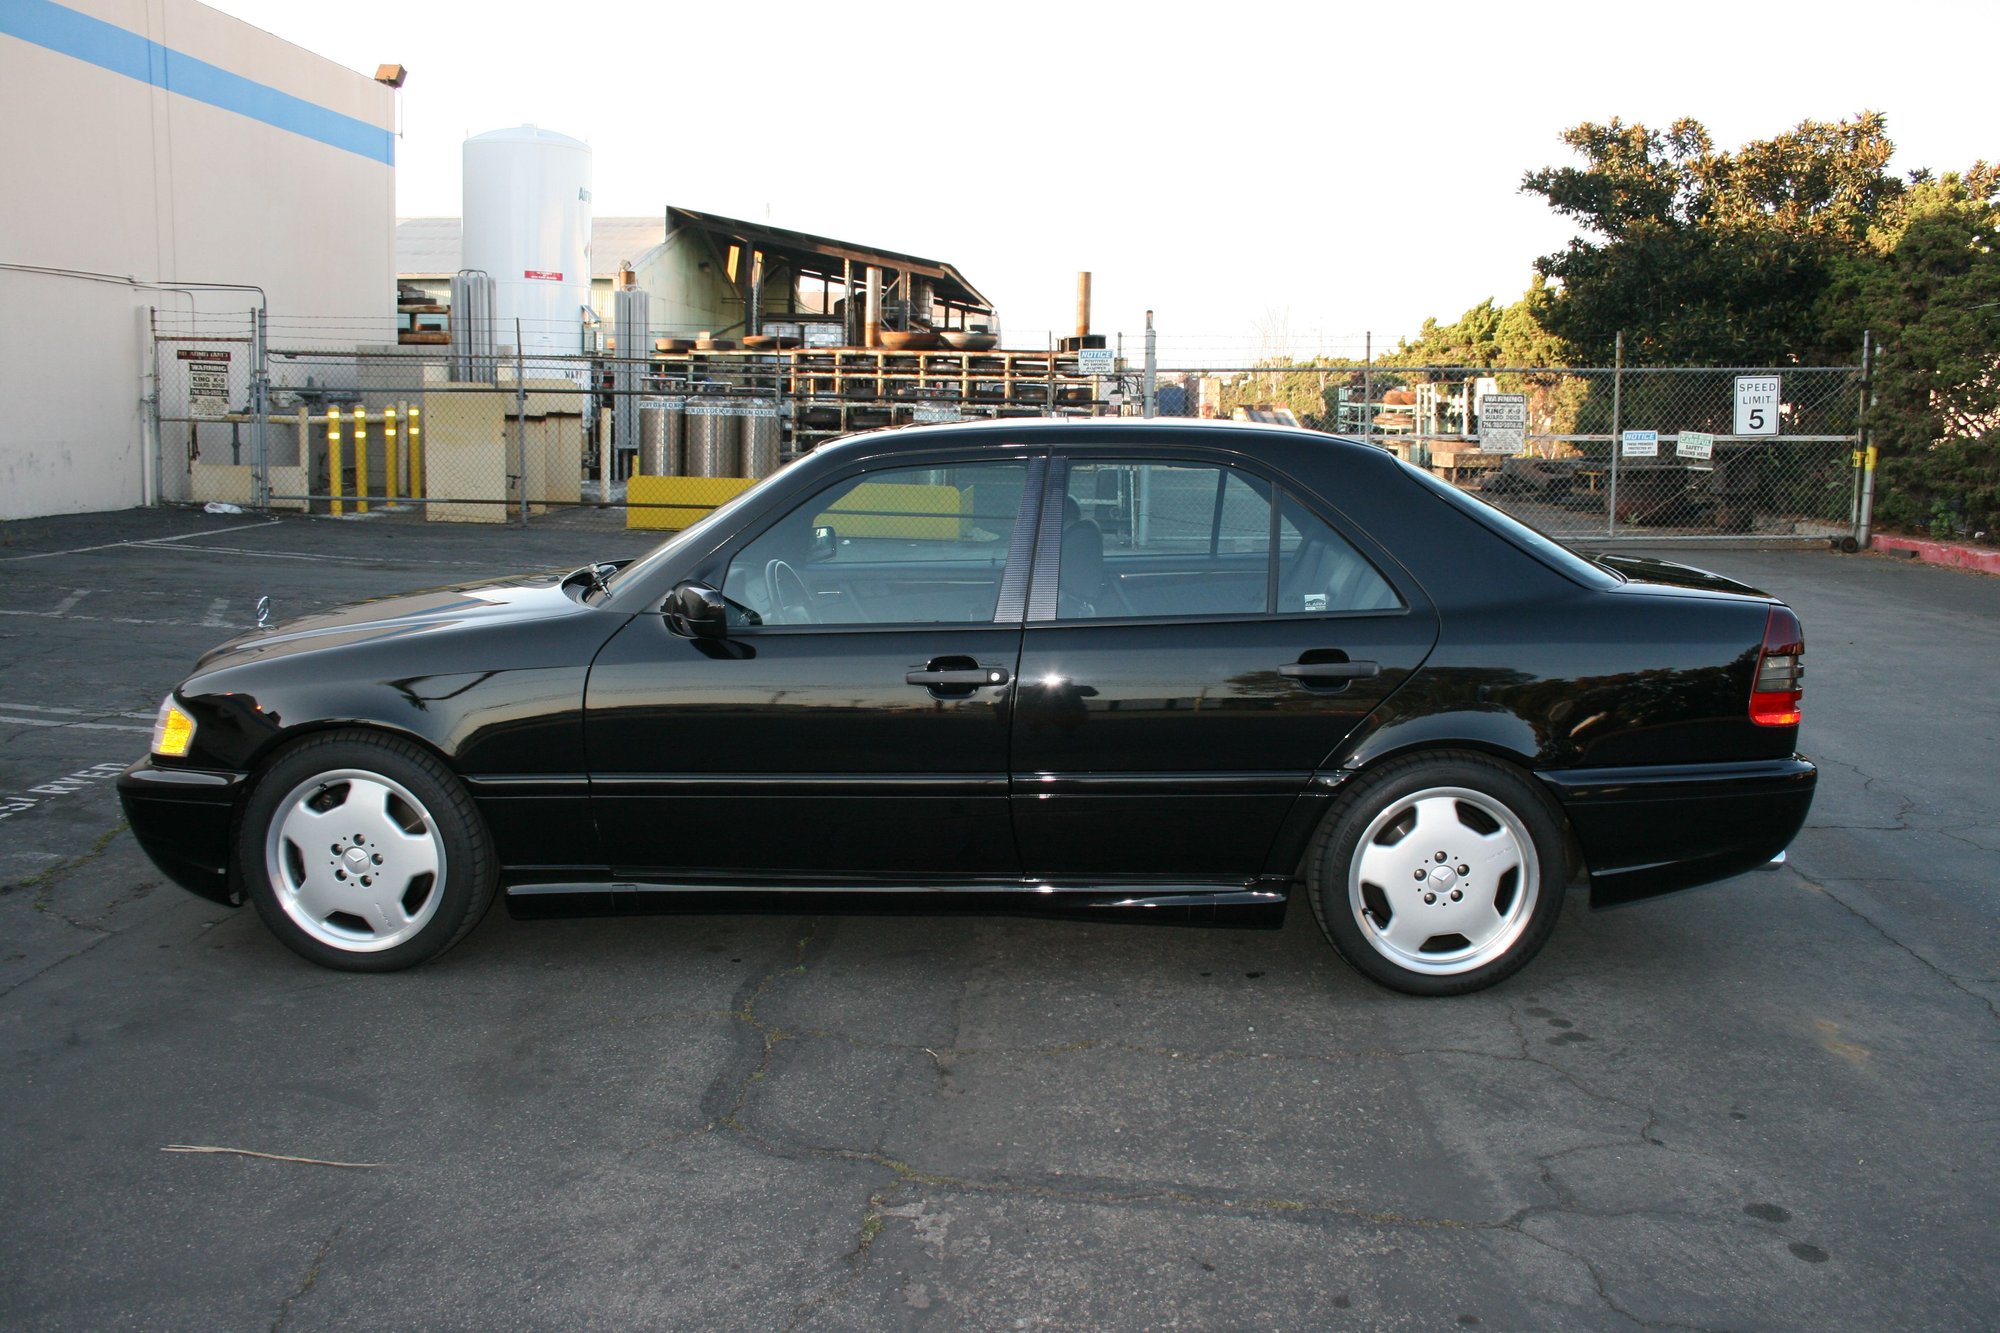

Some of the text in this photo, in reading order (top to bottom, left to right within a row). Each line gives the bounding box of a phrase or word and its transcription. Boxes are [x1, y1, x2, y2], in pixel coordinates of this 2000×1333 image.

[191, 364, 226, 372] WARNING
[1739, 383, 1776, 392] SPEED
[1743, 396, 1771, 405] LIMIT
[1749, 409, 1764, 429] 5
[1681, 437, 1711, 446] CAREFUL
